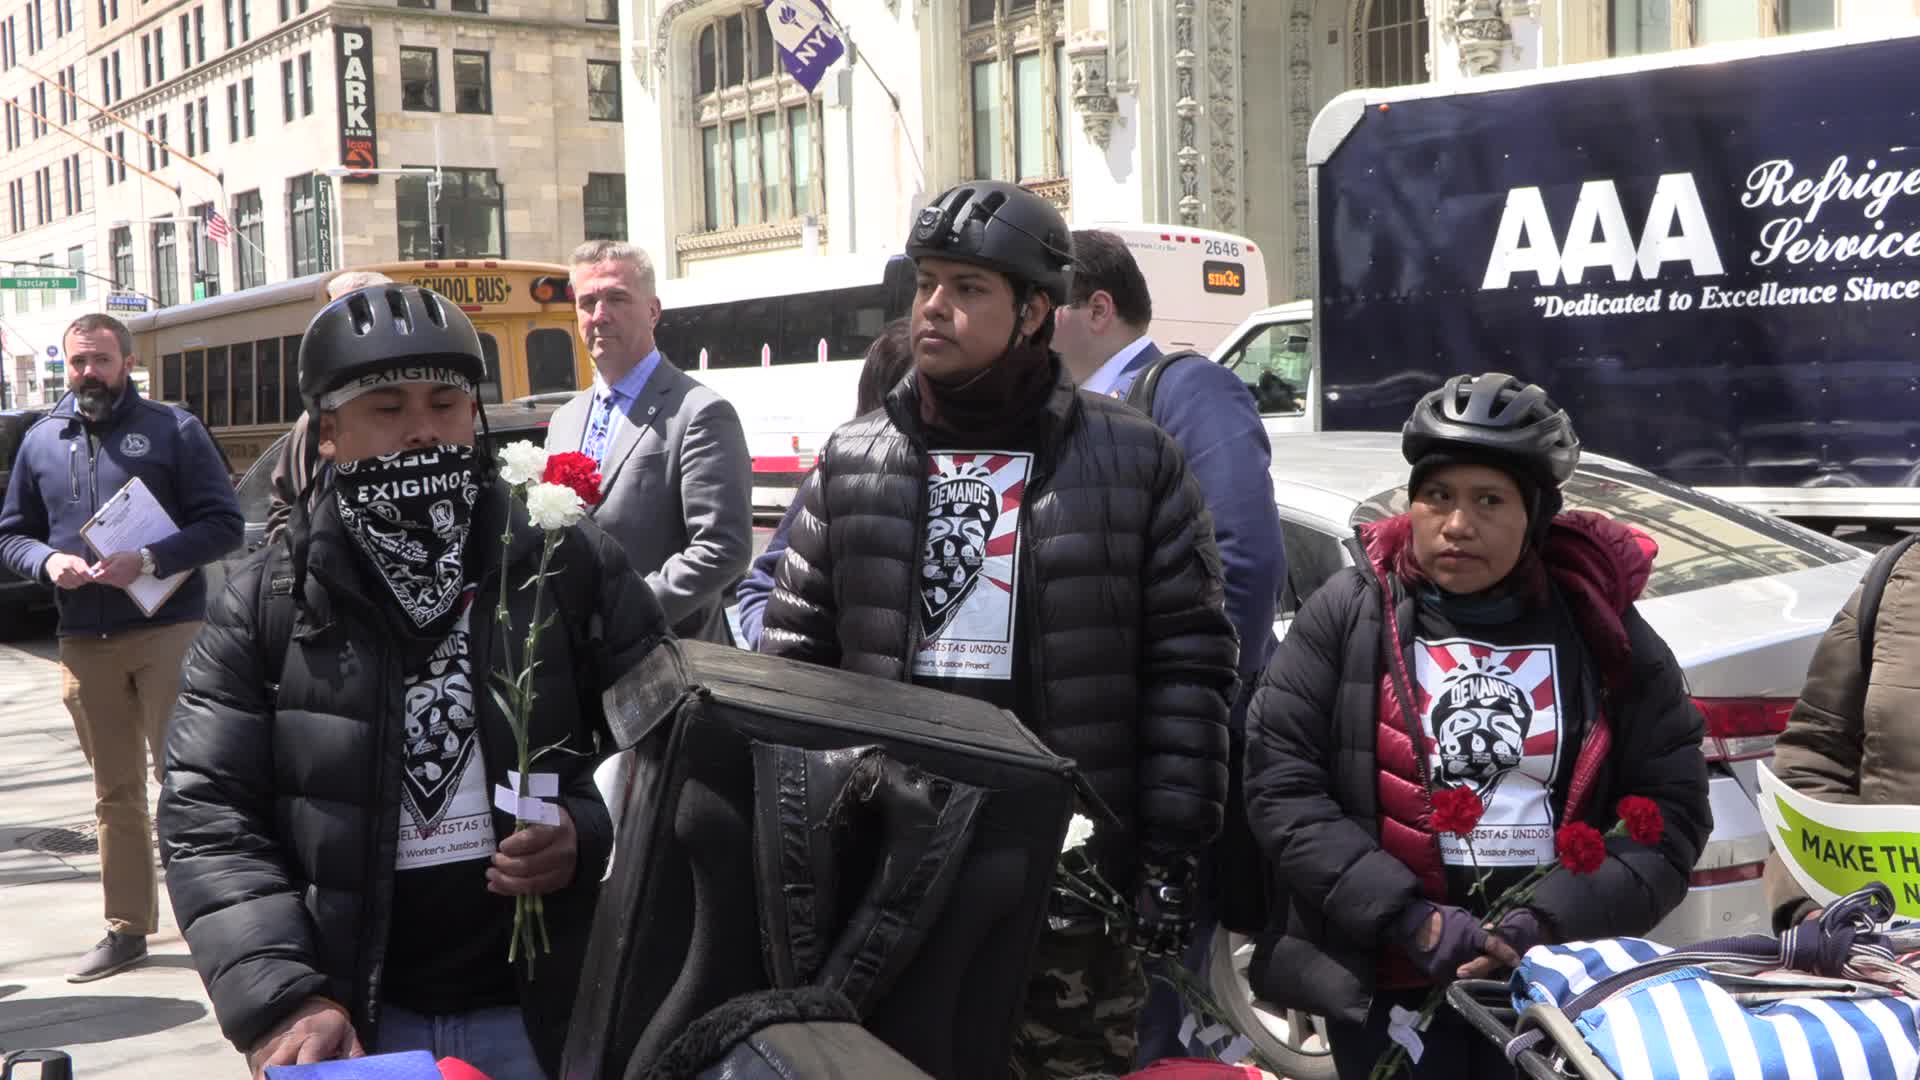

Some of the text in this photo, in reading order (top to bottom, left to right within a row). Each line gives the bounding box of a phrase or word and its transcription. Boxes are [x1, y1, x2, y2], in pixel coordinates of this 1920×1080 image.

[343, 32, 369, 128] PARK
[319, 181, 329, 225] FIRST
[1741, 155, 1920, 223] Refrige
[1481, 172, 1724, 290] AAA
[1751, 217, 1920, 267] Service
[1205, 239, 1239, 257] 2646
[16, 279, 60, 289] Barclay St
[476, 278, 505, 302] BUS
[1669, 292, 1693, 311] to
[1700, 281, 1837, 310] Excellence
[1843, 275, 1919, 303] Since
[357, 470, 472, 503] EXIGIMOS
[929, 481, 990, 508] DEMANDS
[969, 643, 1007, 655] UNIDOS
[1450, 677, 1519, 706] DEMANDS
[1512, 828, 1551, 839] UNIDOS
[406, 845, 446, 859] Worker's
[447, 840, 479, 853] Justice
[1508, 847, 1536, 857] Project
[1801, 828, 1920, 874] MAKE TH
